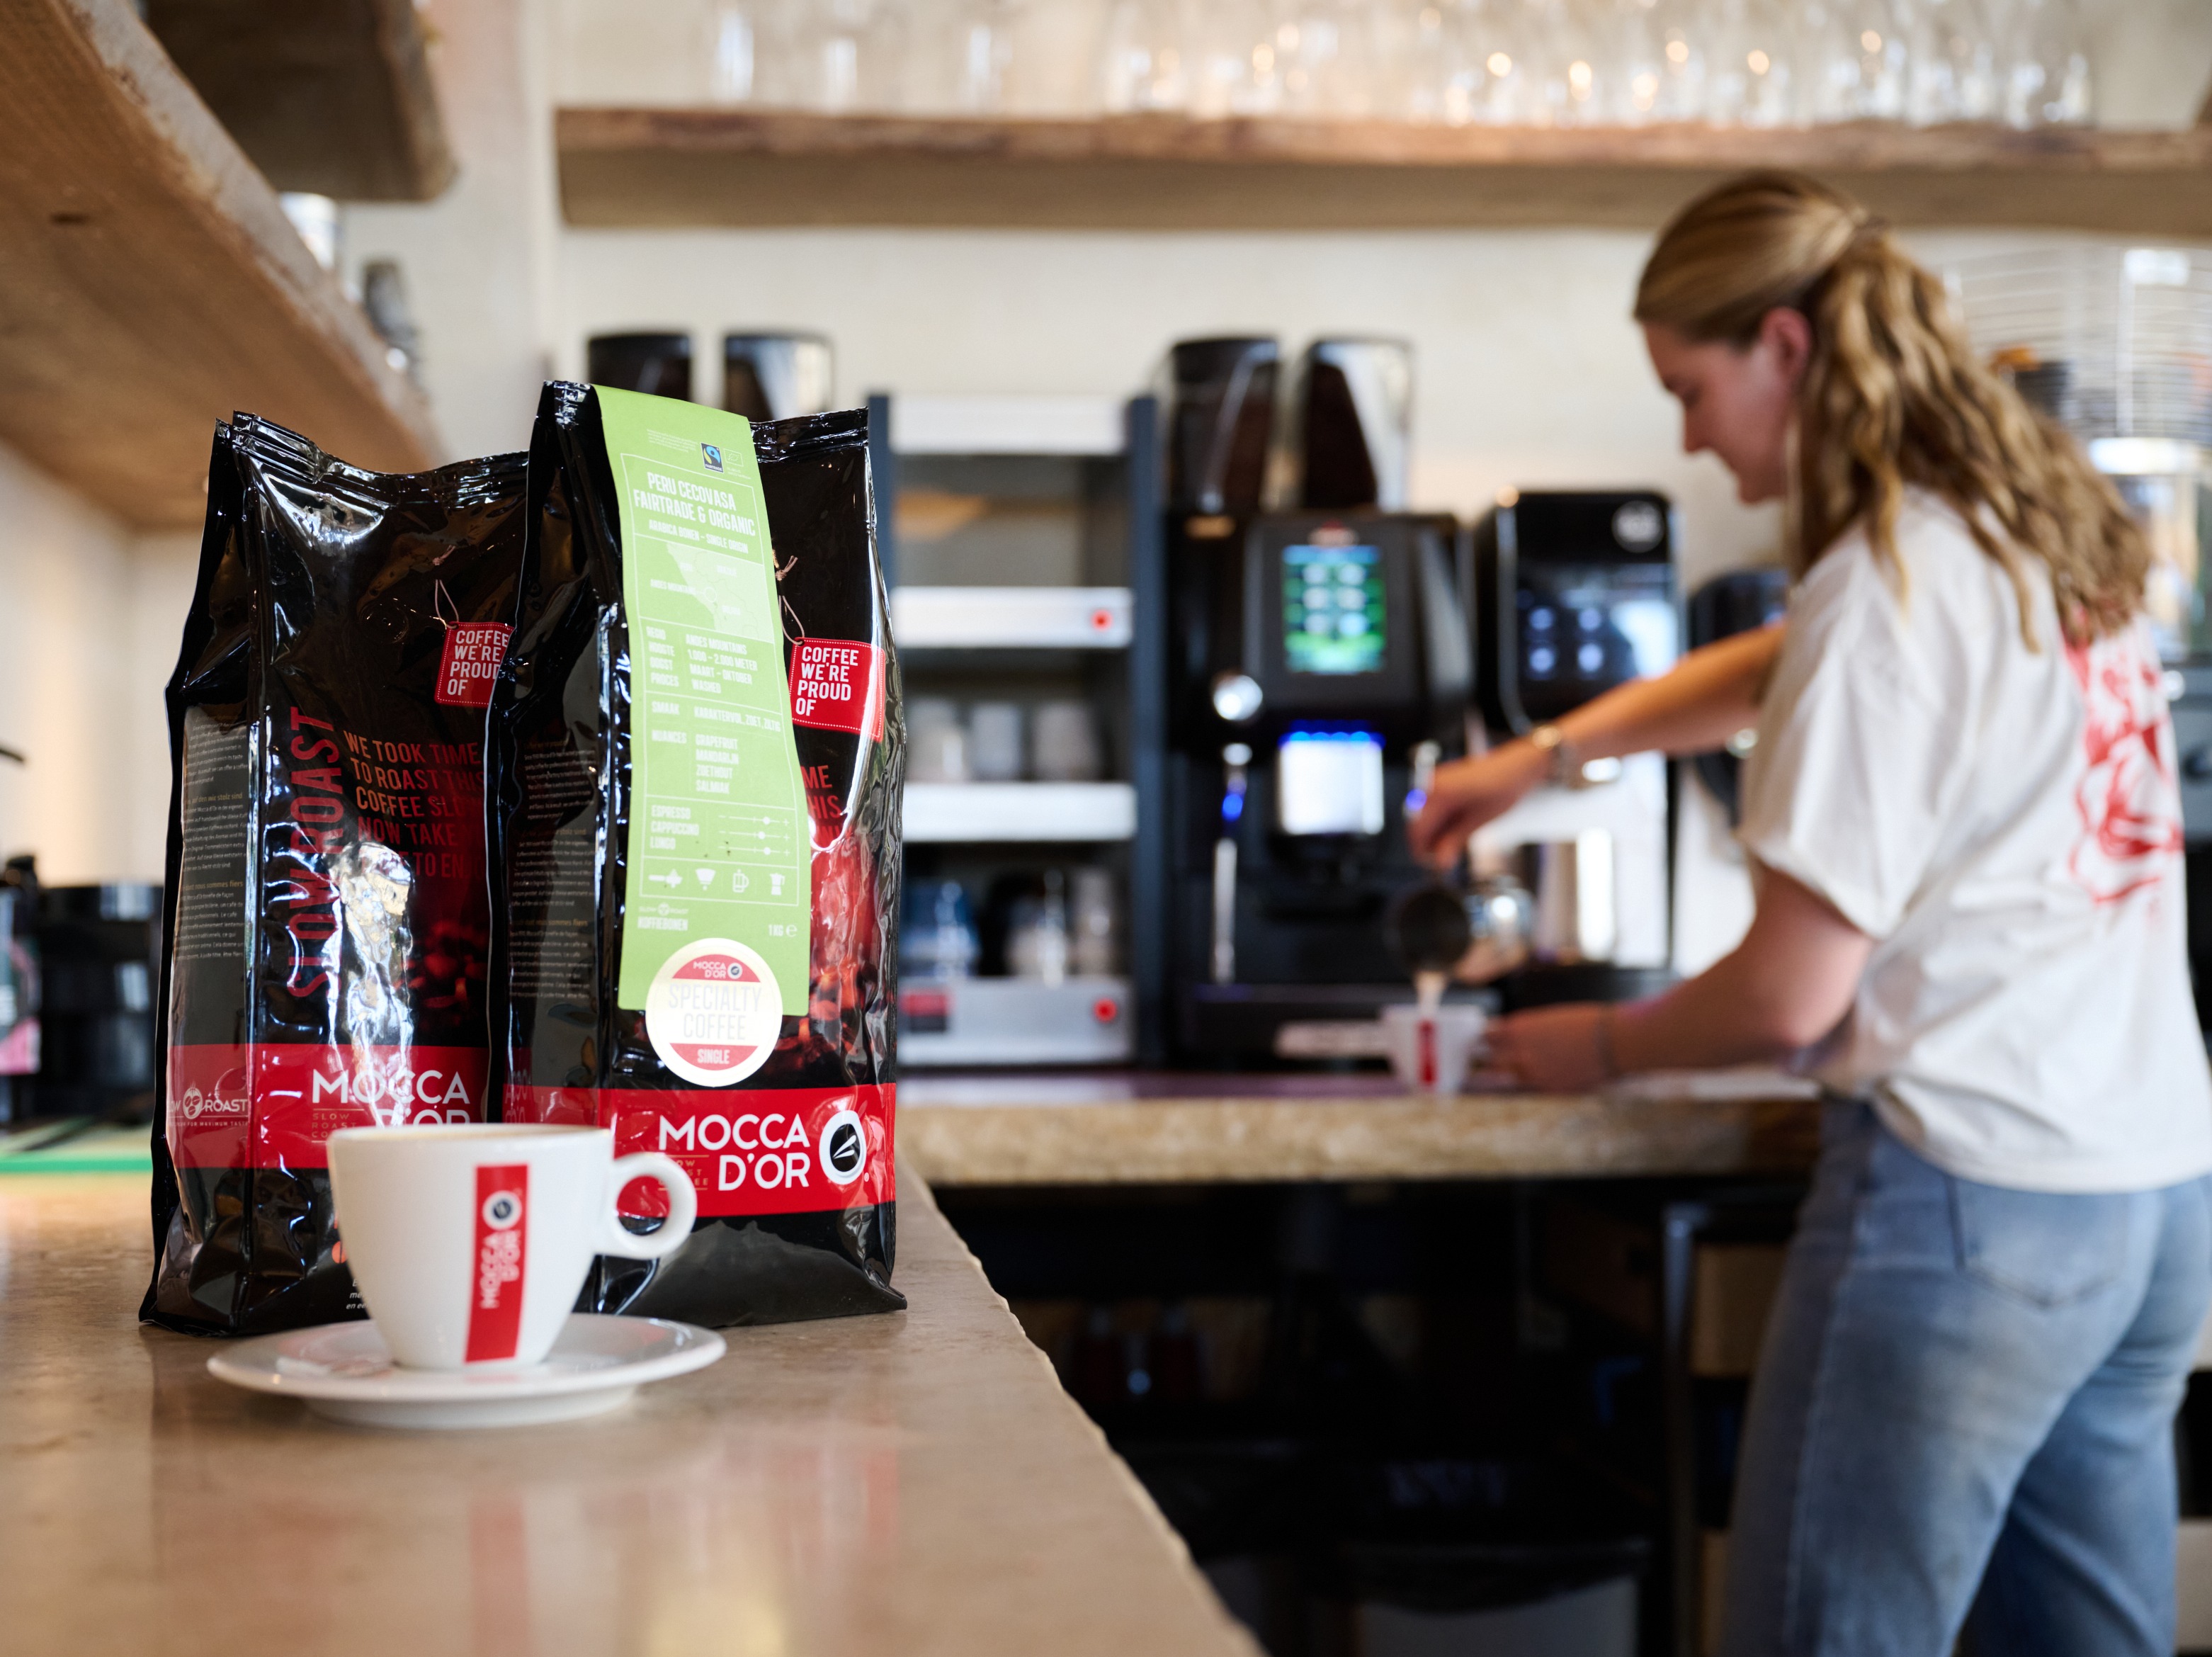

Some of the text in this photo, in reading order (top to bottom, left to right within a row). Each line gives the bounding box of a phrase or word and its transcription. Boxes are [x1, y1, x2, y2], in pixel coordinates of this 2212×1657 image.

[647, 472, 737, 511] PERU CECOVASA
[633, 489, 756, 536] FAIRTRADE & ORGANIC
[649, 519, 749, 554] ARABICA BONEN SINGLE ORIGIN
[455, 630, 510, 647] COFFEE
[708, 638, 748, 655] MOUNTAINS
[455, 643, 501, 662] WE'RE
[802, 646, 859, 666] COFFEE
[689, 663, 715, 677] MAART
[735, 657, 759, 672] METER
[801, 662, 849, 682] WE'RE
[447, 679, 468, 696] OF
[798, 679, 851, 701] PROUD
[651, 700, 681, 716] SMAAK
[795, 697, 817, 716] OF
[651, 729, 687, 744] NUANCES
[343, 730, 482, 765] WE TOOK TIME
[289, 706, 344, 855] ROAST
[350, 757, 373, 784] TO
[375, 766, 439, 791] ROAST
[800, 765, 833, 789] ME
[217, 793, 230, 801] stolz
[356, 786, 425, 818] COFFEE
[358, 816, 400, 845] NOW
[405, 823, 458, 847] TAKE
[414, 852, 436, 877] TO
[693, 961, 726, 970] MOCCA
[705, 970, 726, 978] D'OR
[668, 983, 762, 1012] SPECIALTY
[684, 1012, 746, 1040] COFFEE
[697, 1048, 730, 1064] SINGLE
[312, 1068, 470, 1104] MOCCA
[205, 1099, 248, 1112] ROAST
[659, 1113, 810, 1151] MOCCA
[718, 1152, 811, 1192] D'OR
